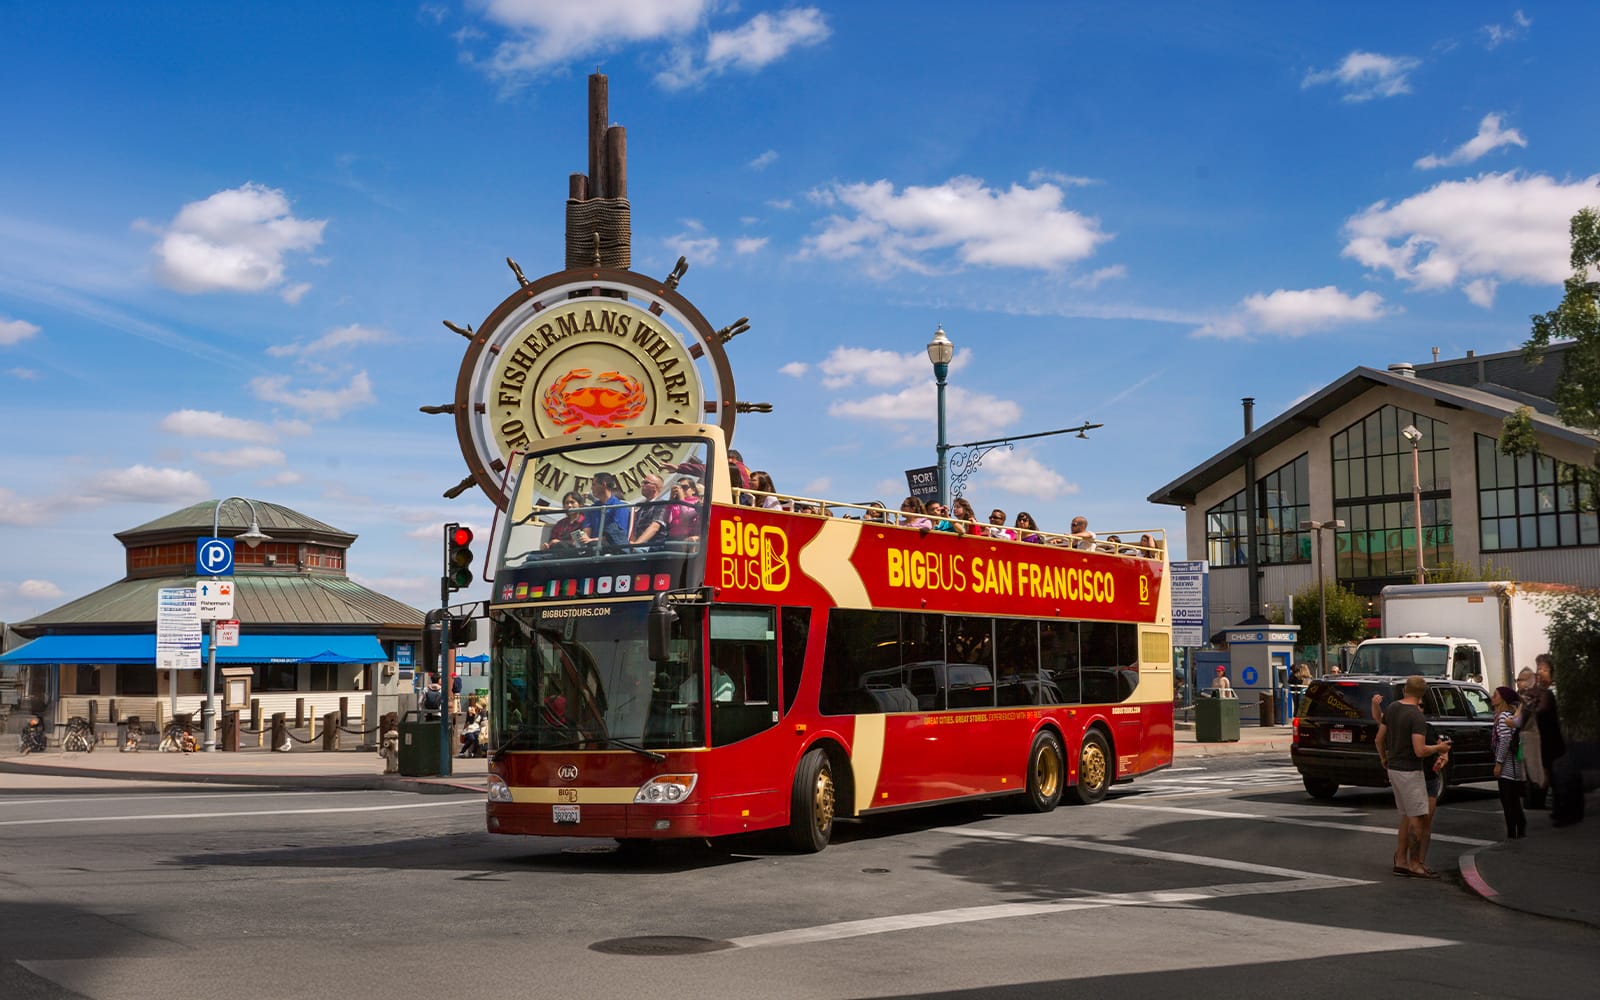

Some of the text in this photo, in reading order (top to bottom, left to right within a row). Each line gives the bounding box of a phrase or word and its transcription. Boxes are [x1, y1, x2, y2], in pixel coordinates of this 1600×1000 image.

[499, 309, 690, 408] FISHERMANS WHARF
[501, 418, 530, 449] OF
[912, 472, 933, 484] PORT
[922, 485, 938, 494] YEARS
[720, 519, 760, 558] BIG
[721, 556, 761, 590] BUS
[971, 556, 1013, 596] SAN
[1018, 561, 1115, 604] FRANCISCO
[542, 607, 611, 619] BIGBUSTOURS.COM
[1231, 633, 1257, 641] CHASE
[1271, 632, 1289, 640] CHASE
